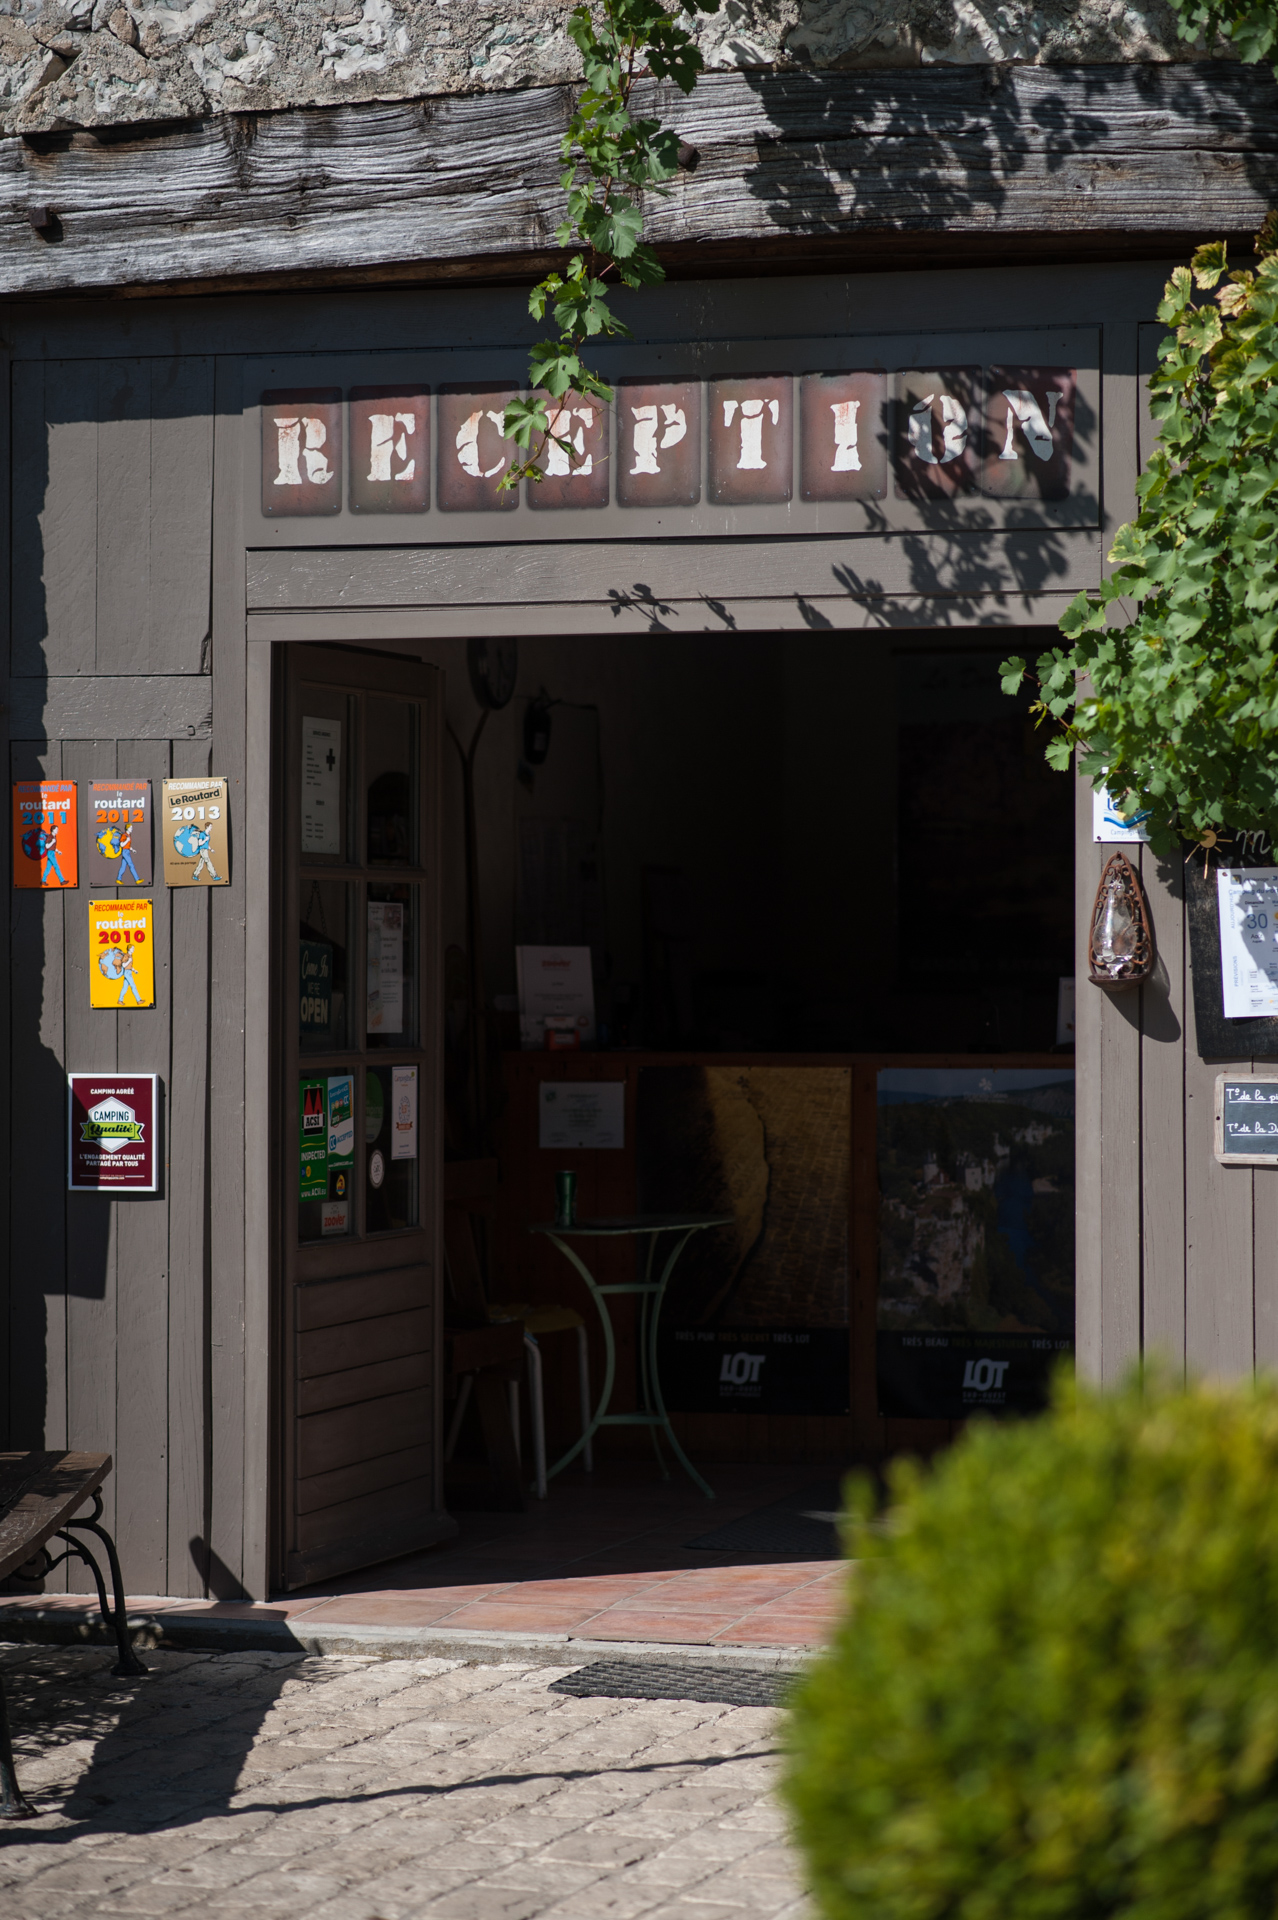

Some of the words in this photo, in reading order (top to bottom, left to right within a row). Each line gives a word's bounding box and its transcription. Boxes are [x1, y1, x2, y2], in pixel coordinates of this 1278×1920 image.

[273, 389, 1064, 485] RECEPTION
[18, 783, 60, 792] RECOMMANDÉ
[60, 784, 72, 792] PAR
[93, 781, 134, 791] RECOMMANDÉ
[210, 781, 223, 789] PAR
[94, 797, 145, 809] routard
[170, 797, 181, 806] Le
[181, 789, 220, 804] Routard
[20, 798, 70, 810] routard
[22, 811, 67, 825] 2011
[96, 809, 144, 823] 2012
[171, 806, 220, 821] 2013
[94, 902, 135, 912] RECOMMANDÉ
[96, 918, 146, 929] routard
[1247, 913, 1268, 929] 30
[99, 930, 145, 944] 2010
[301, 950, 318, 980] Come
[301, 996, 329, 1024] OPEN
[1237, 1090, 1251, 1100] de
[1255, 1089, 1266, 1100] la
[94, 1111, 129, 1121] CAMPING
[89, 1124, 133, 1136] Qualité
[1238, 1124, 1251, 1132] de
[1255, 1121, 1266, 1133] la
[301, 1150, 325, 1161] INSPECTED
[324, 1214, 346, 1227] zoover
[795, 1334, 810, 1344] LOT
[925, 1337, 949, 1347] BEAU
[1055, 1340, 1071, 1349] LOT
[719, 1351, 767, 1385] LOT
[961, 1357, 1010, 1391] LOT
